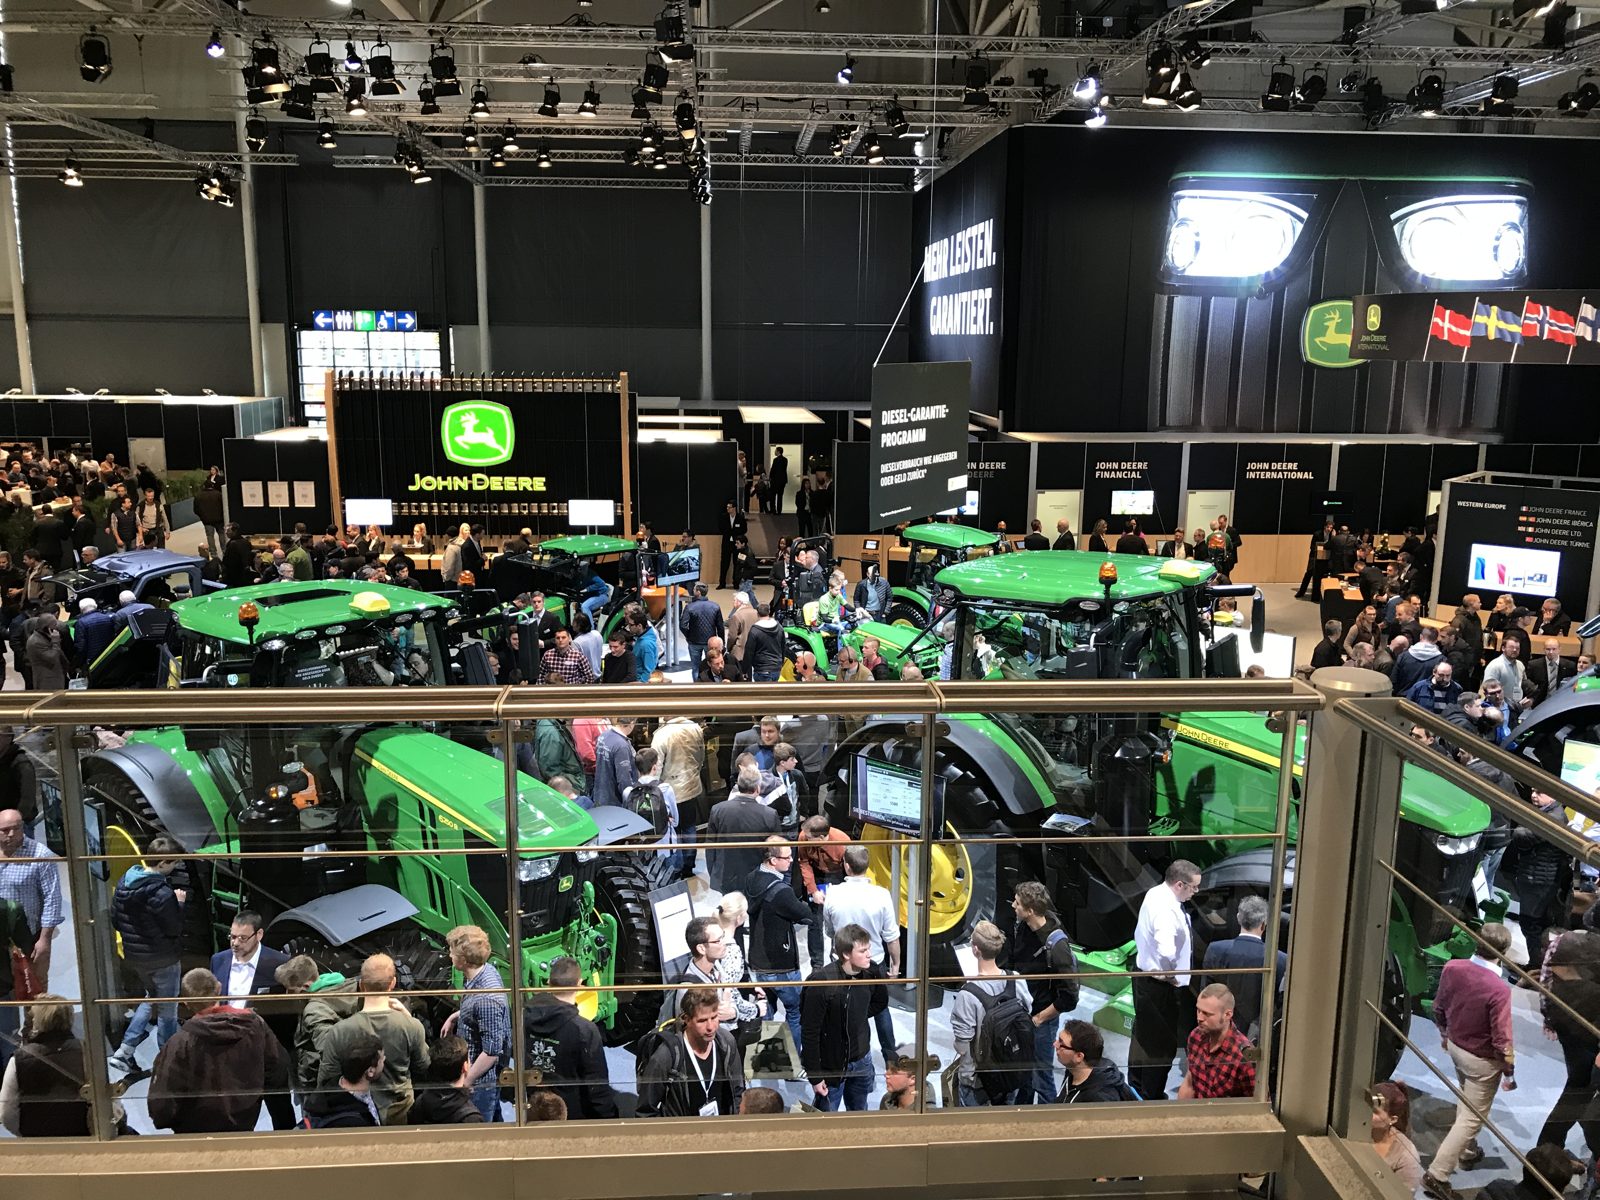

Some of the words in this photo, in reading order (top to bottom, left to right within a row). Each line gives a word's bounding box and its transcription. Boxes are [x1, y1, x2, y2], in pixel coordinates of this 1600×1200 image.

[924, 238, 949, 283] MEHR
[949, 218, 996, 277] LEISTEN.
[930, 287, 994, 336] GARANTIERT.
[881, 404, 950, 426] DIESEL-GARANTIE-
[881, 428, 927, 448] PROGRAMM
[923, 454, 933, 465] WIE
[979, 461, 1007, 470] DEERE
[1095, 461, 1119, 470] JOHN
[1120, 461, 1149, 470] DEERE
[1246, 462, 1270, 470] JOHN
[1271, 462, 1298, 470] DEERE
[880, 475, 894, 487] ODER
[894, 471, 907, 484] GELD
[1095, 470, 1142, 479] FINANCIAL
[1246, 471, 1314, 480] INTERNATIONAL
[408, 473, 469, 491] JOHN
[471, 473, 547, 491] DEERE
[1457, 500, 1484, 509] WESTERN
[1484, 502, 1507, 510] EUROPE
[1545, 507, 1564, 515] DEERE
[1564, 509, 1588, 517] FRANCE
[1552, 518, 1571, 526] DEERE
[1551, 528, 1569, 536] DEERE
[1550, 538, 1568, 547] DEERE
[1178, 725, 1201, 739] JOHN
[1200, 732, 1230, 749] DEERE
